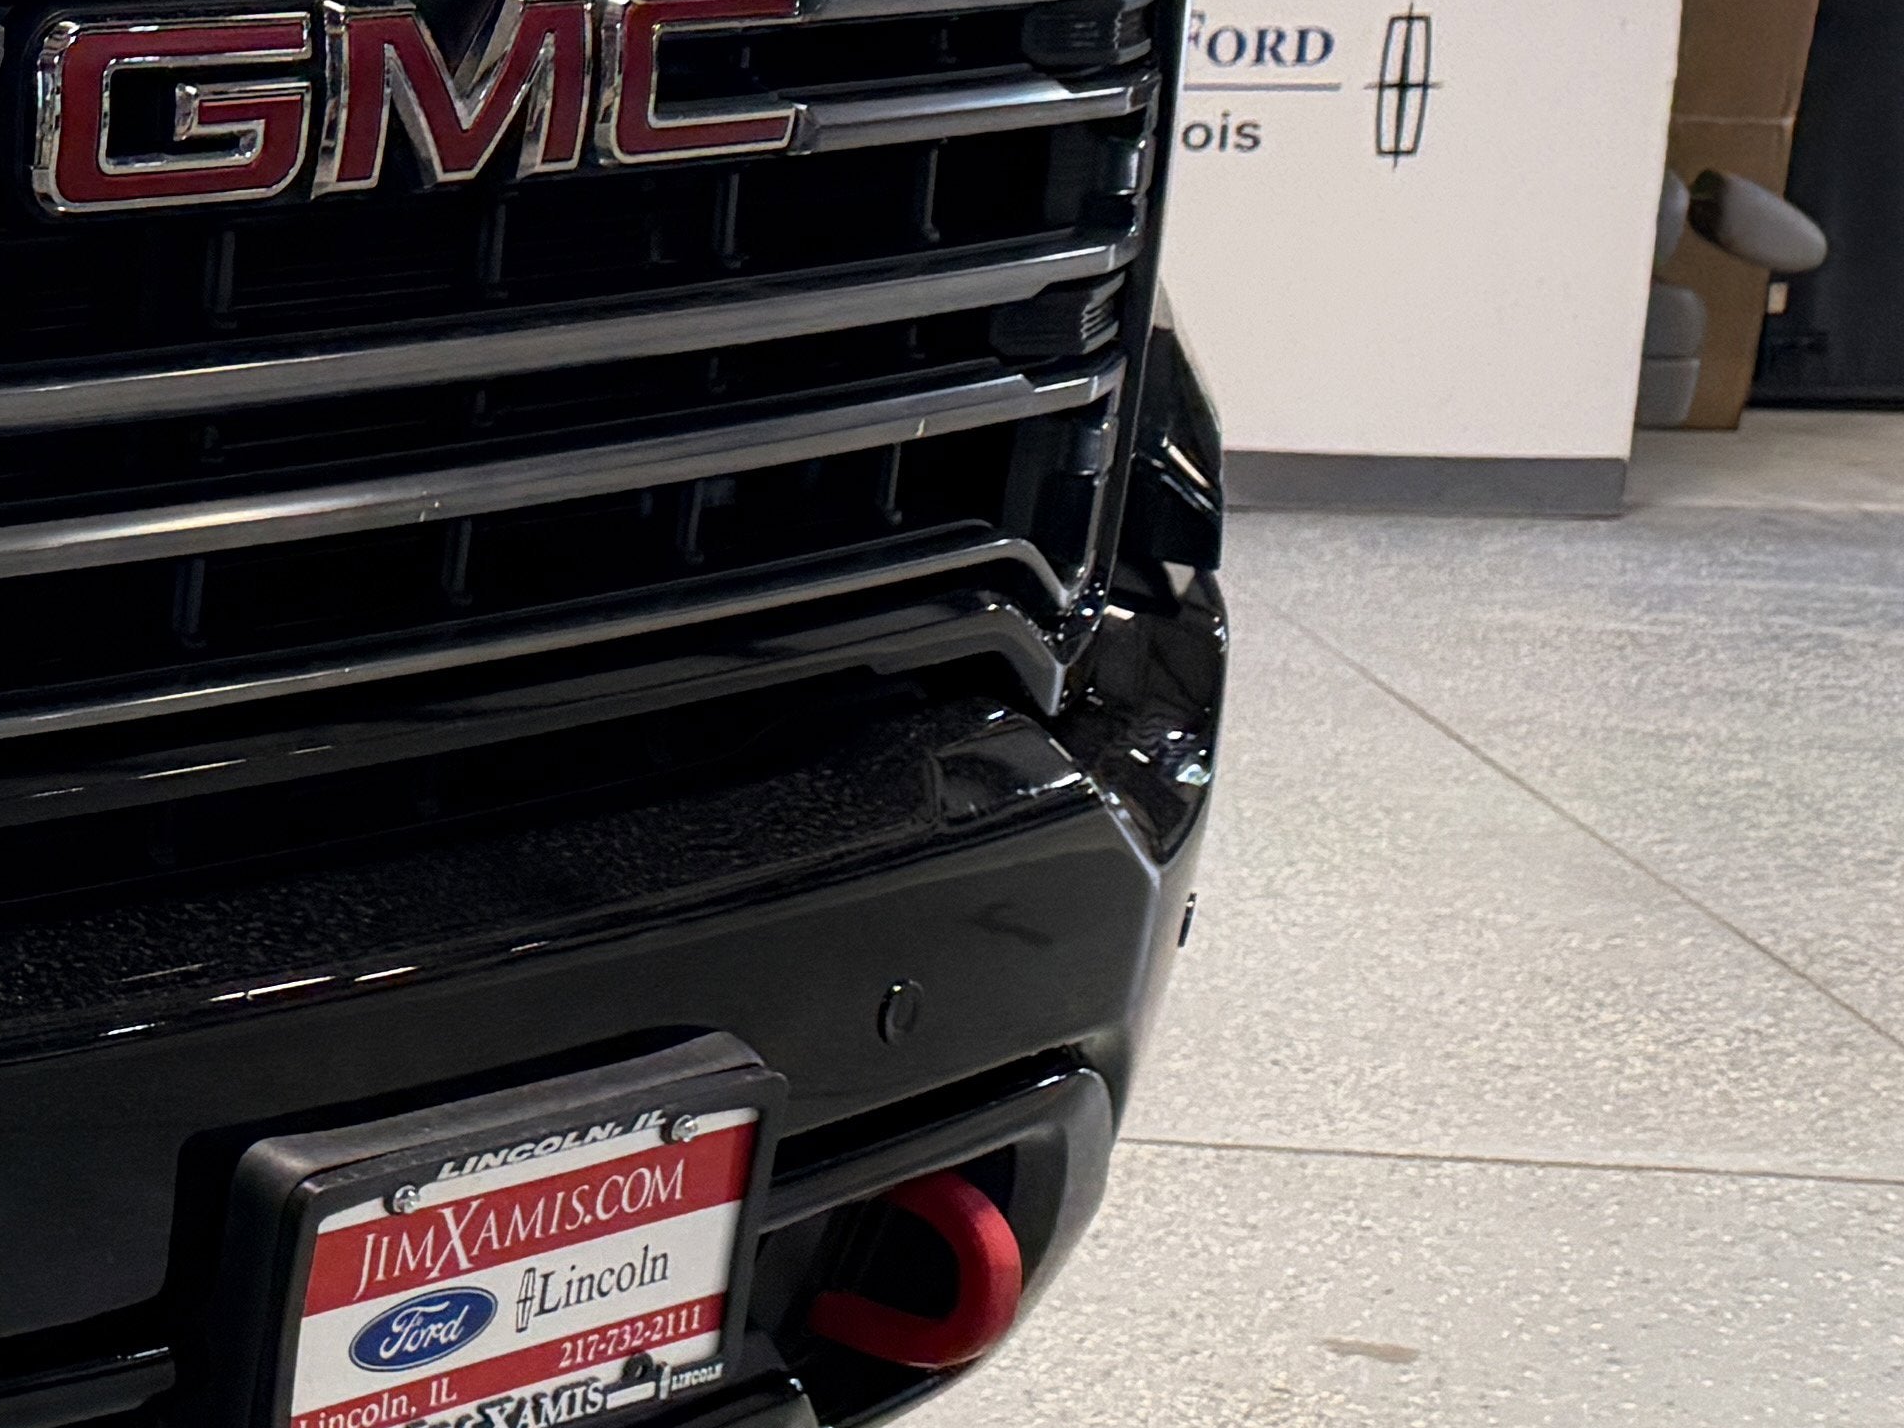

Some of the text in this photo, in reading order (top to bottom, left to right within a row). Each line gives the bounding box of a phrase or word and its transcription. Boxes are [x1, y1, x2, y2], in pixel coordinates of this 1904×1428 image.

[353, 1158, 686, 1301] JIMXAMIS.COM
[533, 1243, 669, 1318] Lincoln
[379, 1290, 470, 1361] Ford
[558, 1304, 703, 1369] 217-732-2111
[428, 1376, 458, 1407] IL
